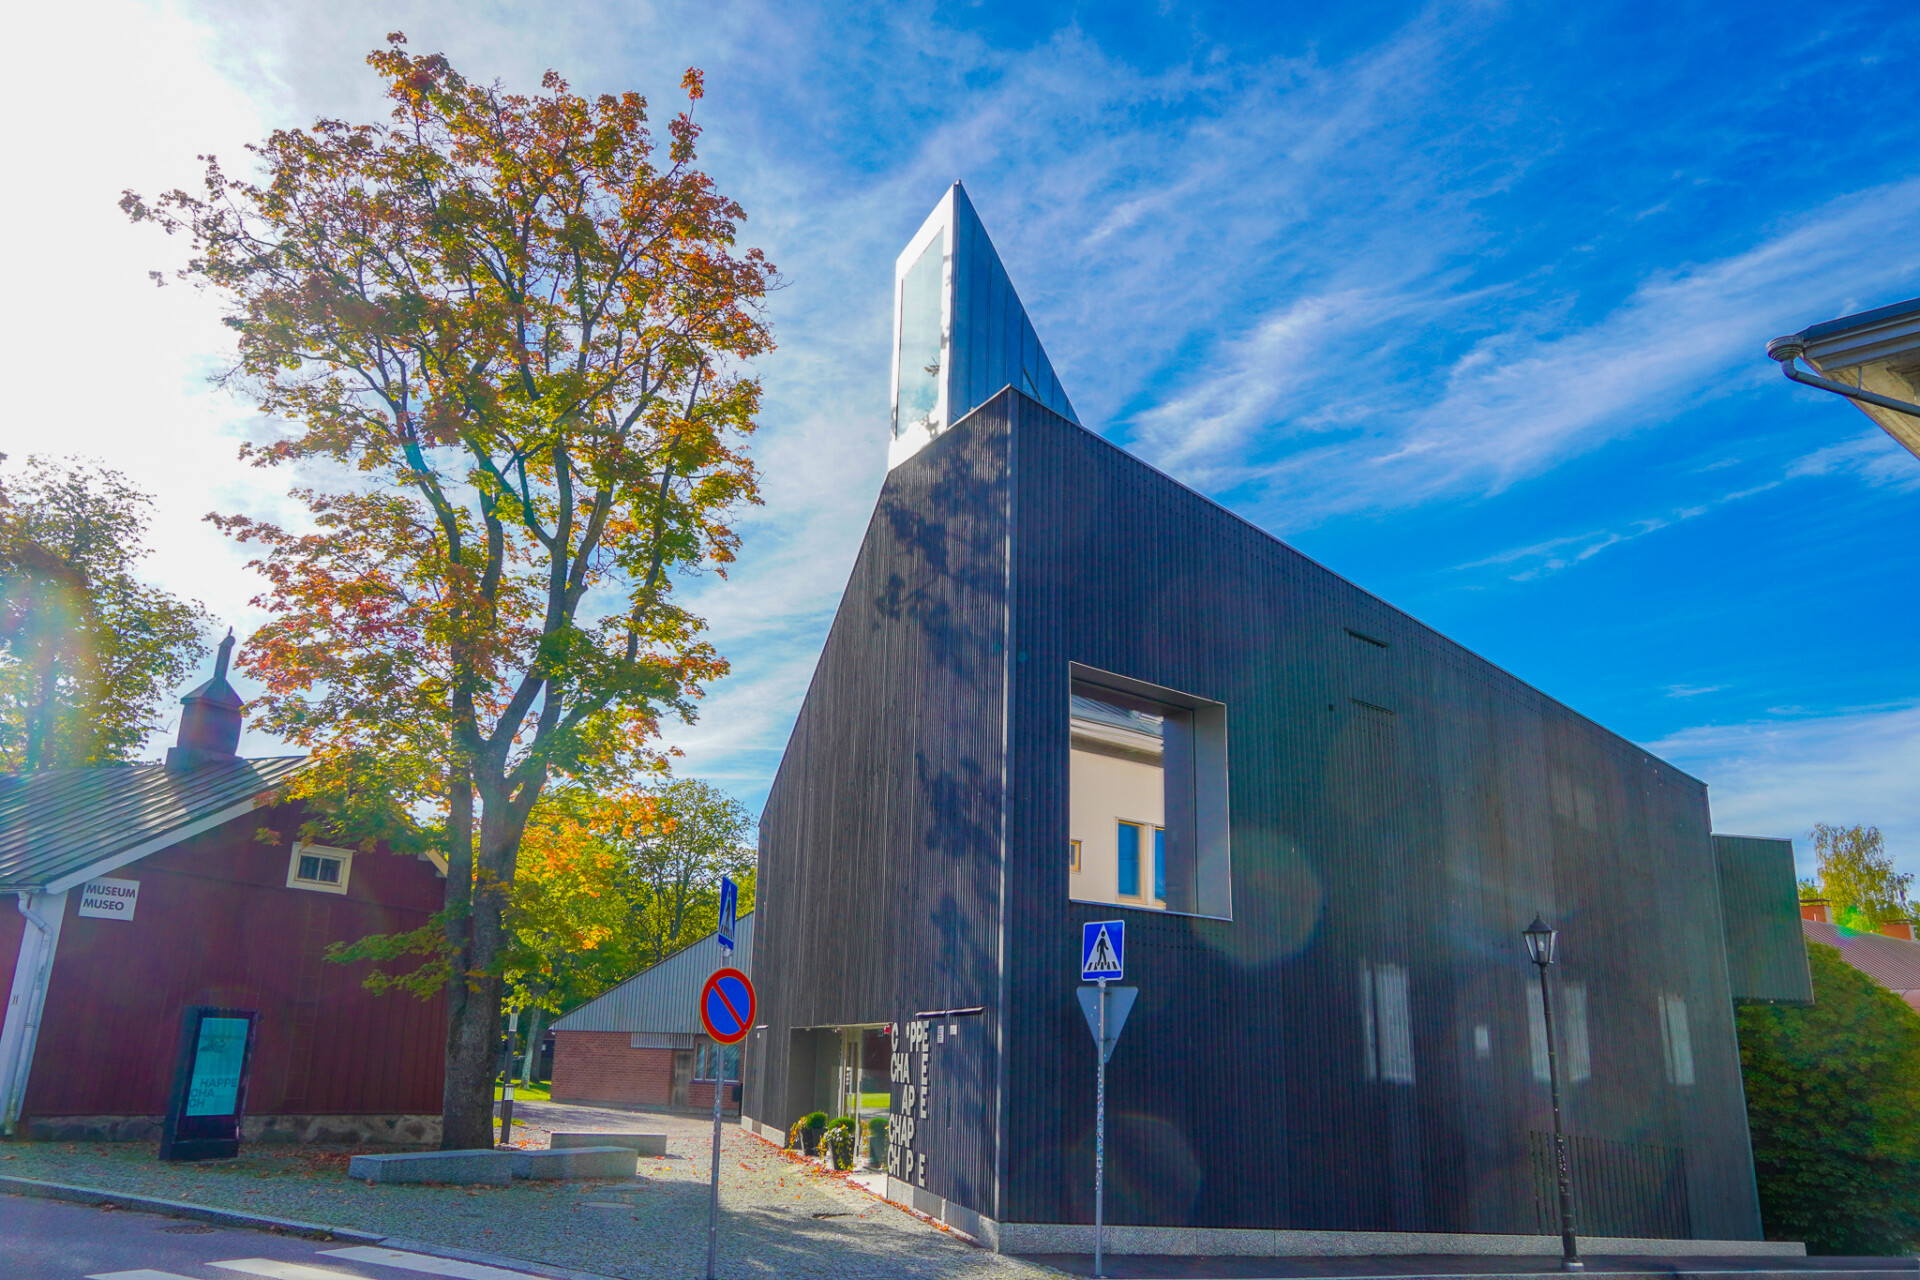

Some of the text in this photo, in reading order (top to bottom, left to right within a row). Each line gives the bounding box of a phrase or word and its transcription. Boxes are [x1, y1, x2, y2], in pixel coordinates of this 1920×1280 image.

[86, 884, 136, 899] MUSEUM
[83, 898, 124, 911] MUSEO
[200, 1078, 238, 1088] HAPPE
[190, 1088, 215, 1098] CHA
[189, 1098, 205, 1108] CH
